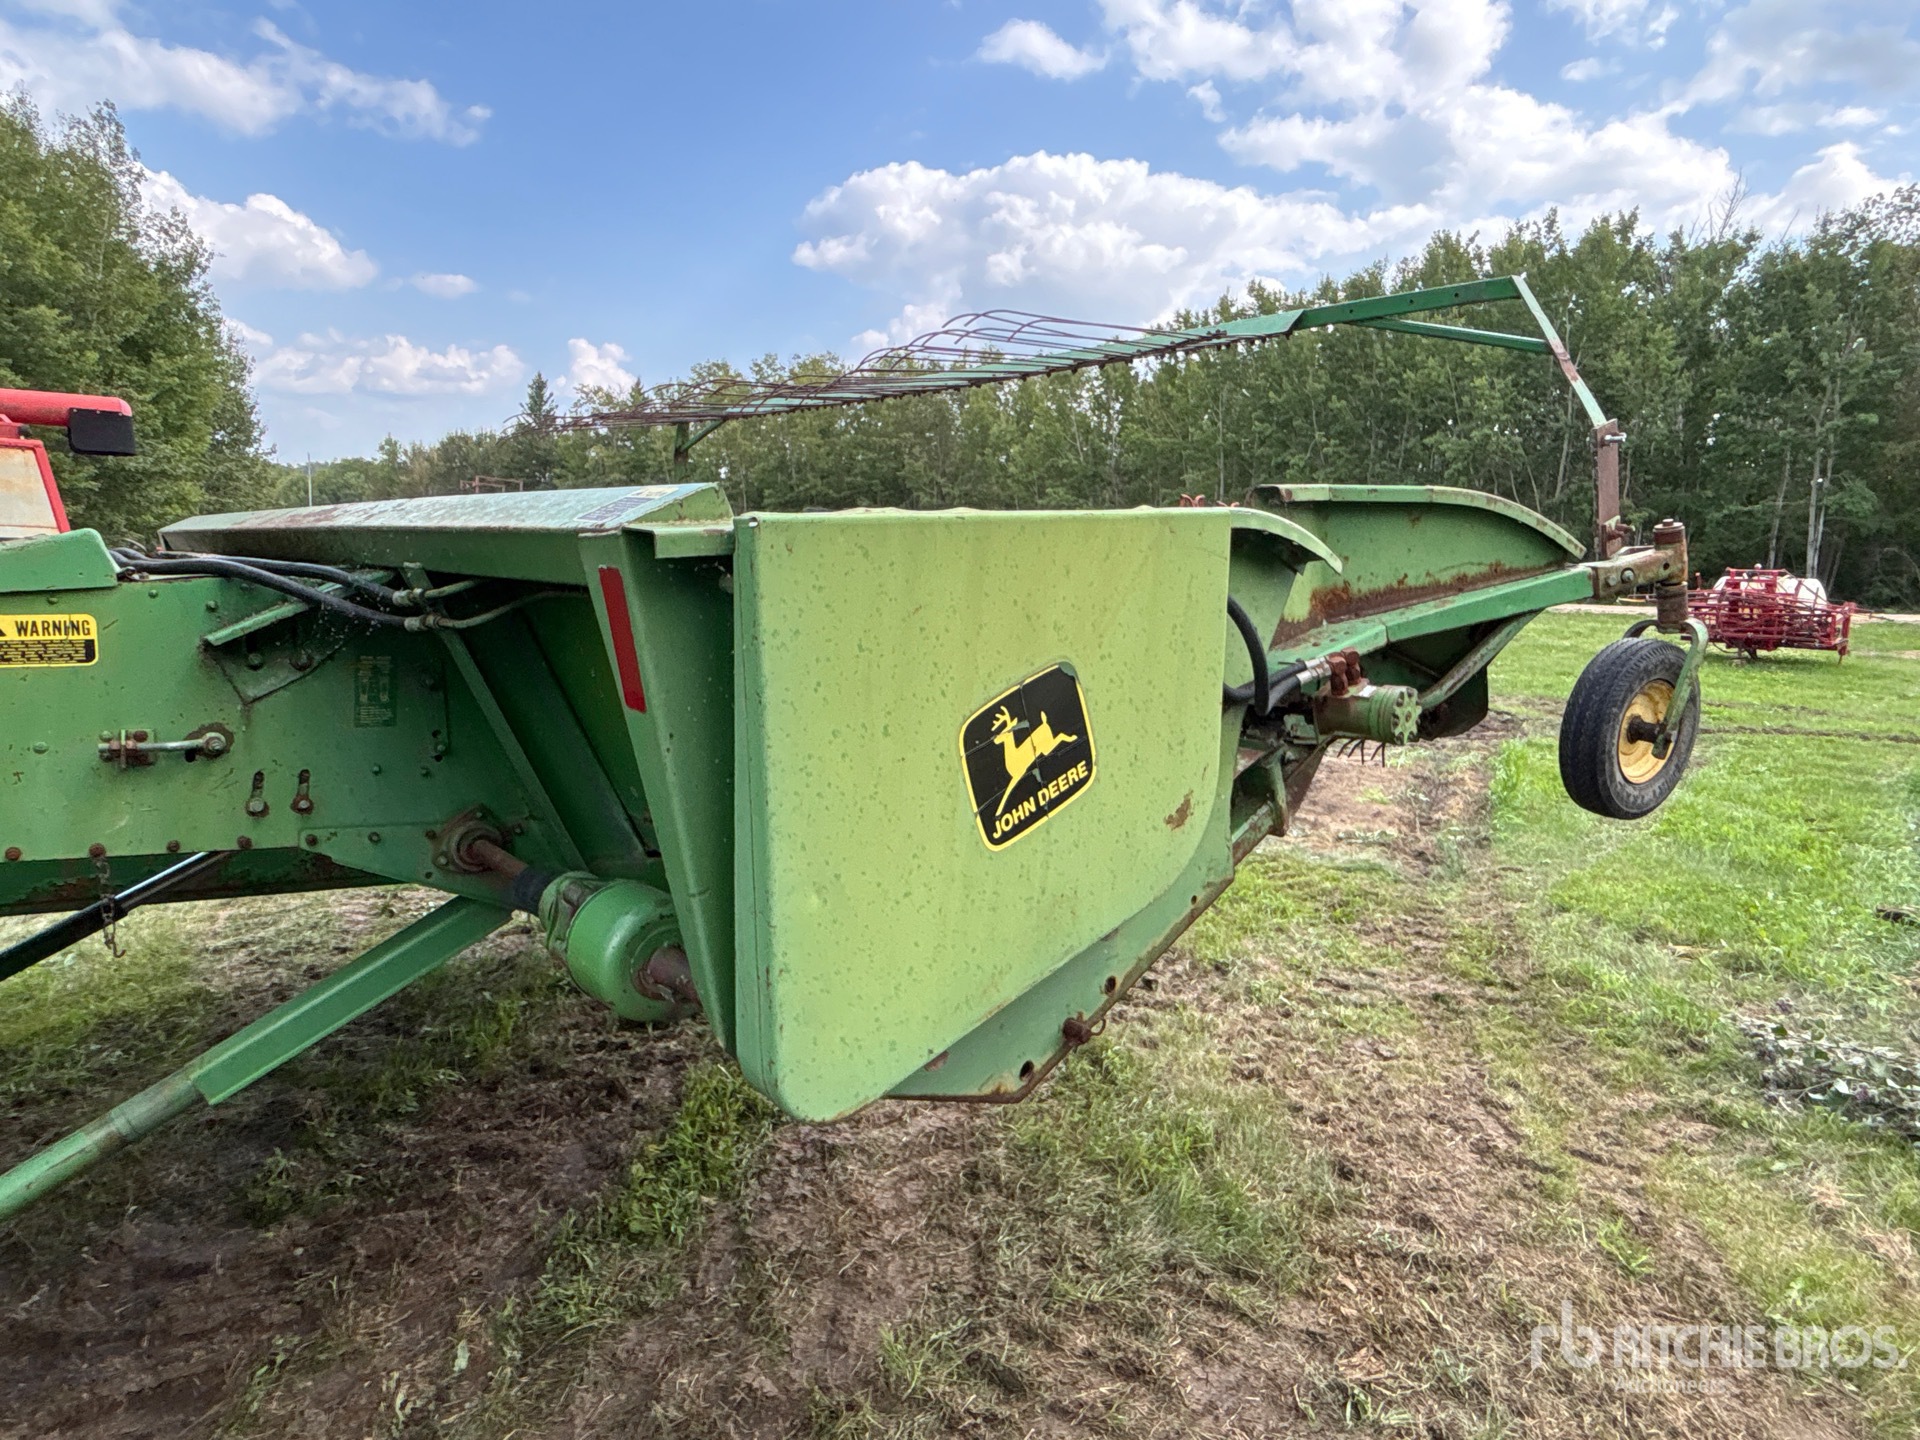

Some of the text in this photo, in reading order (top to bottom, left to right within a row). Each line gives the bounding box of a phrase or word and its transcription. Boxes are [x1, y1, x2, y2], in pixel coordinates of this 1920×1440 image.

[14, 620, 91, 637] WARNING
[993, 760, 1089, 839] JOHN DEERE
